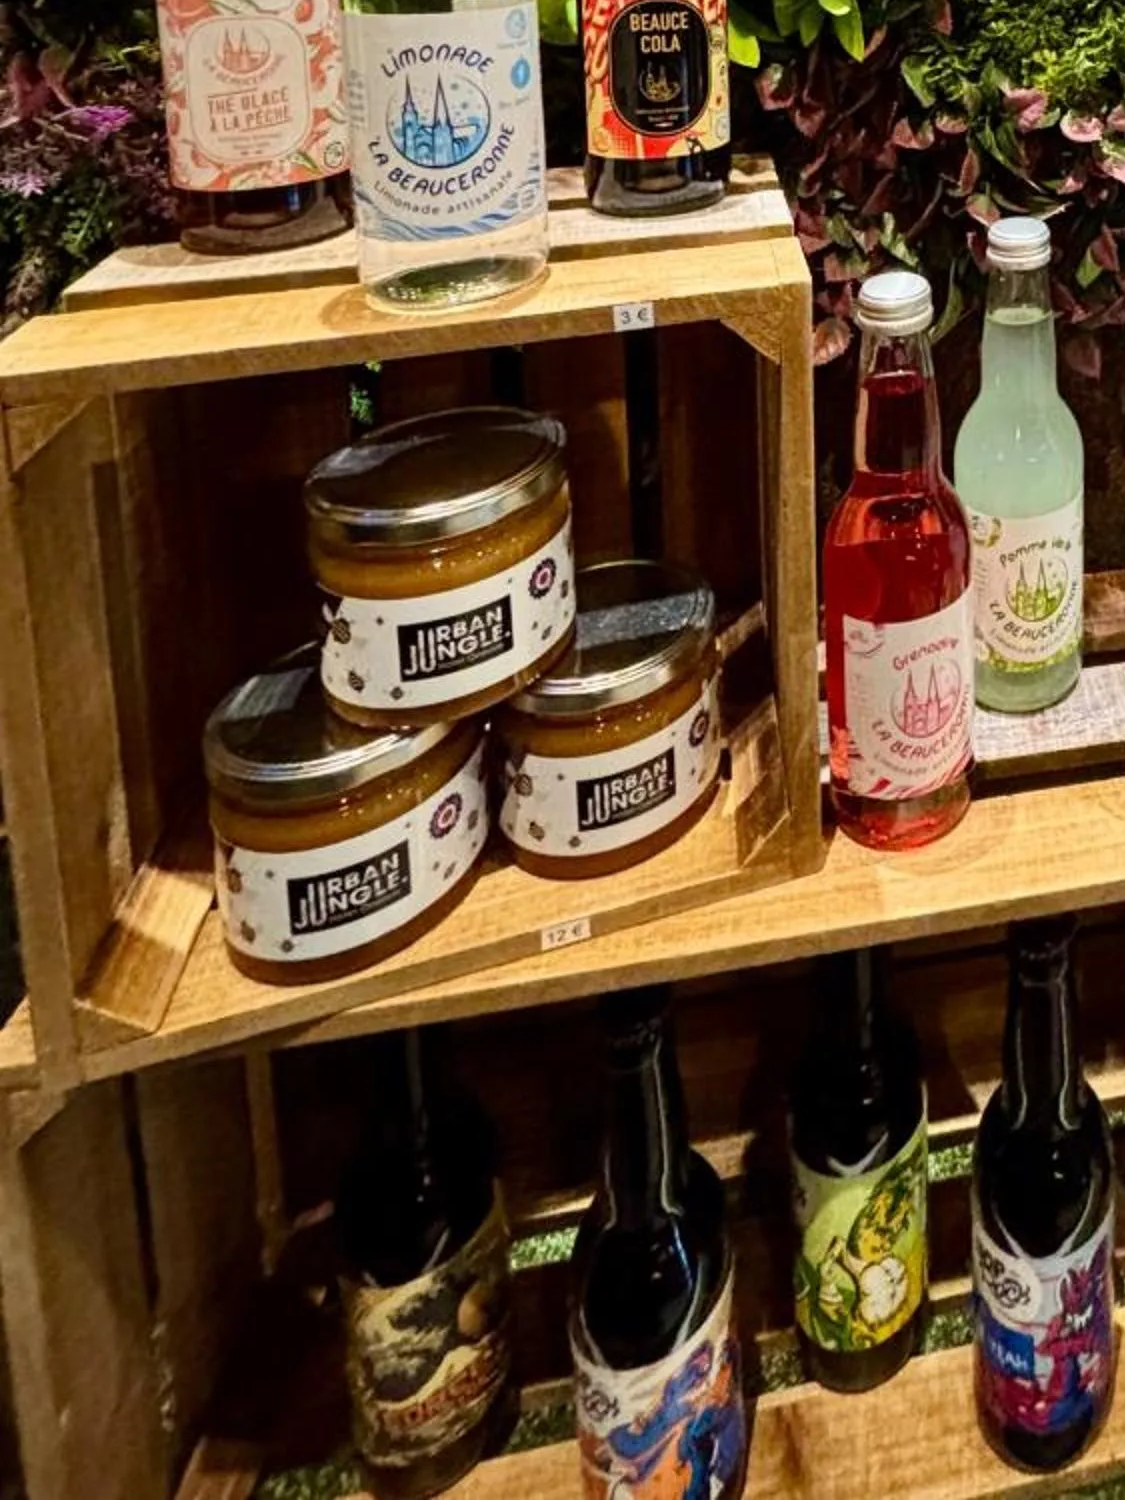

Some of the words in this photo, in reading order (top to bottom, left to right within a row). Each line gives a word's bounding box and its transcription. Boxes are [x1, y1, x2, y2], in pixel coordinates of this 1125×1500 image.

[629, 11, 690, 32] BEAUCE
[640, 35, 682, 53] COLA
[380, 43, 495, 79] LIMONADE
[368, 135, 390, 167] LA
[387, 122, 516, 197] BEAUCERONNE
[417, 606, 503, 673] URBAN
[593, 757, 667, 823] URBAN
[307, 852, 400, 926] URBAN
